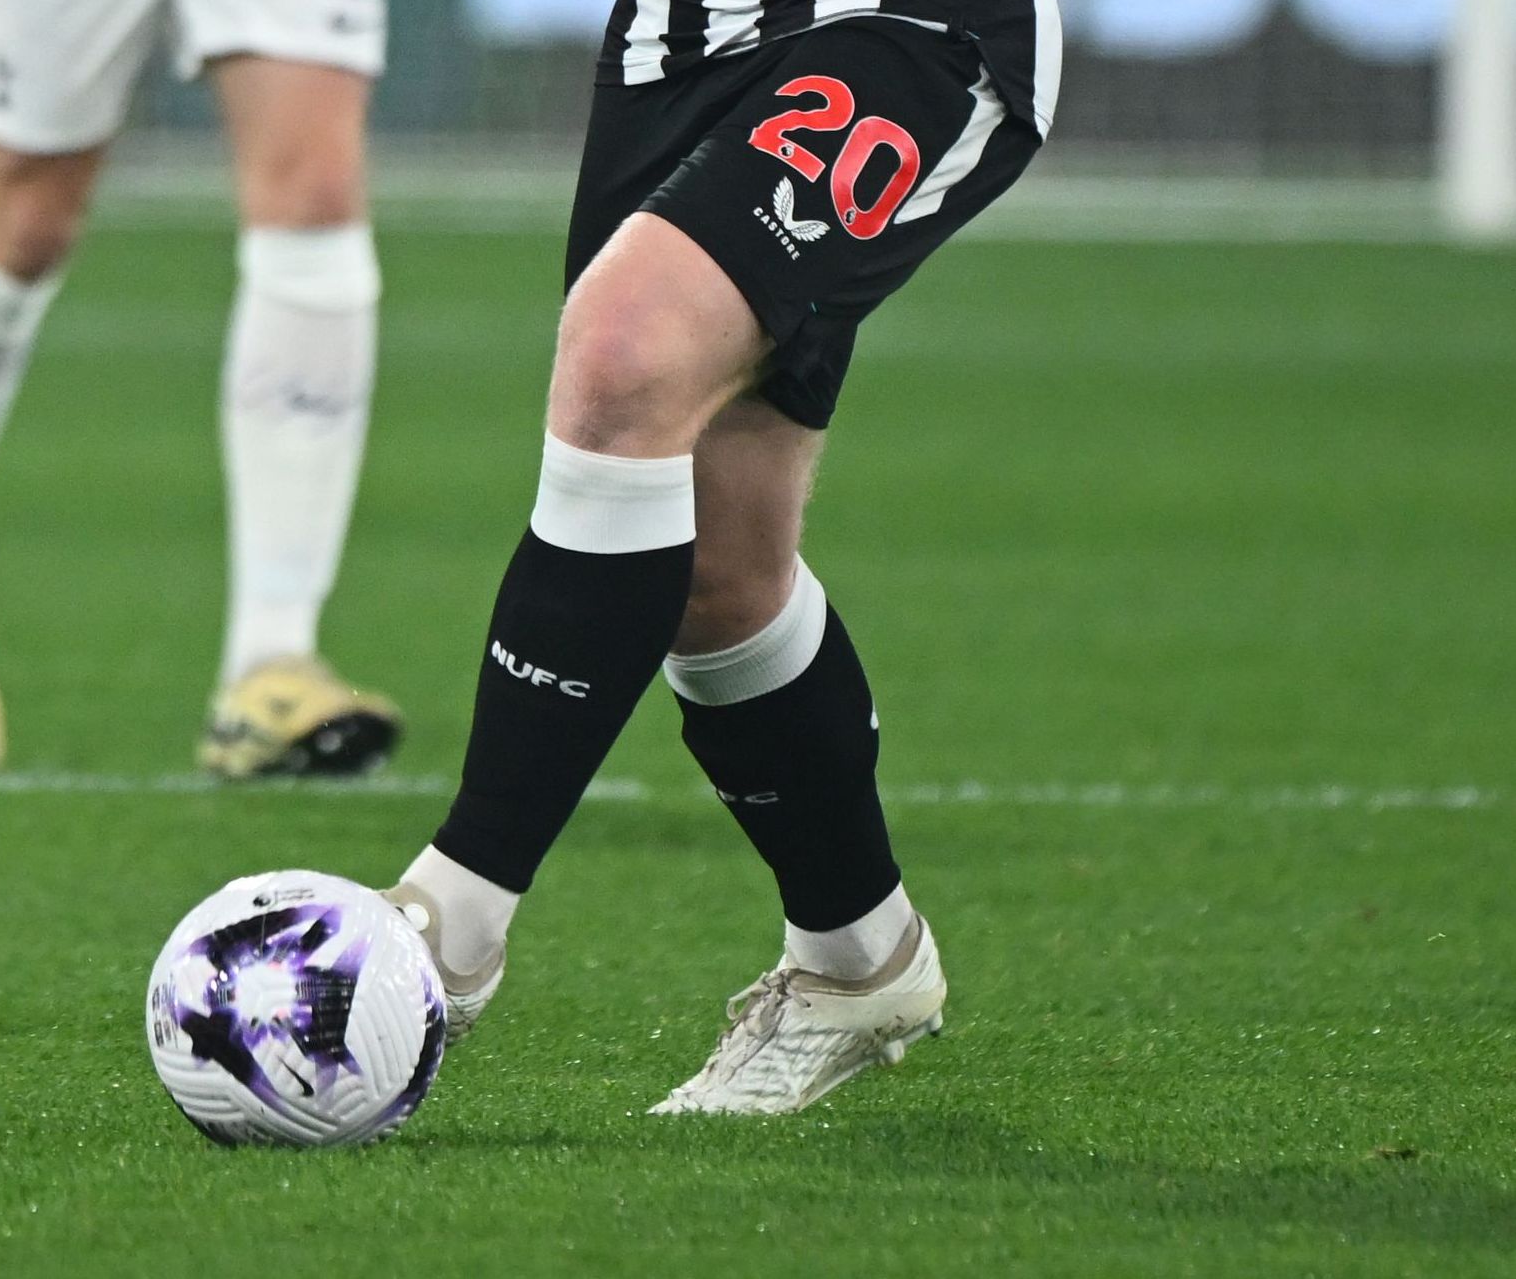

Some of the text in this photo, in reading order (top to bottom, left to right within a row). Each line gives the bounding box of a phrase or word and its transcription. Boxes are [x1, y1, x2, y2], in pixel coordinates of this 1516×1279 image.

[747, 74, 921, 241] 20
[753, 207, 801, 261] CASTORE
[491, 639, 591, 698] NUFC
